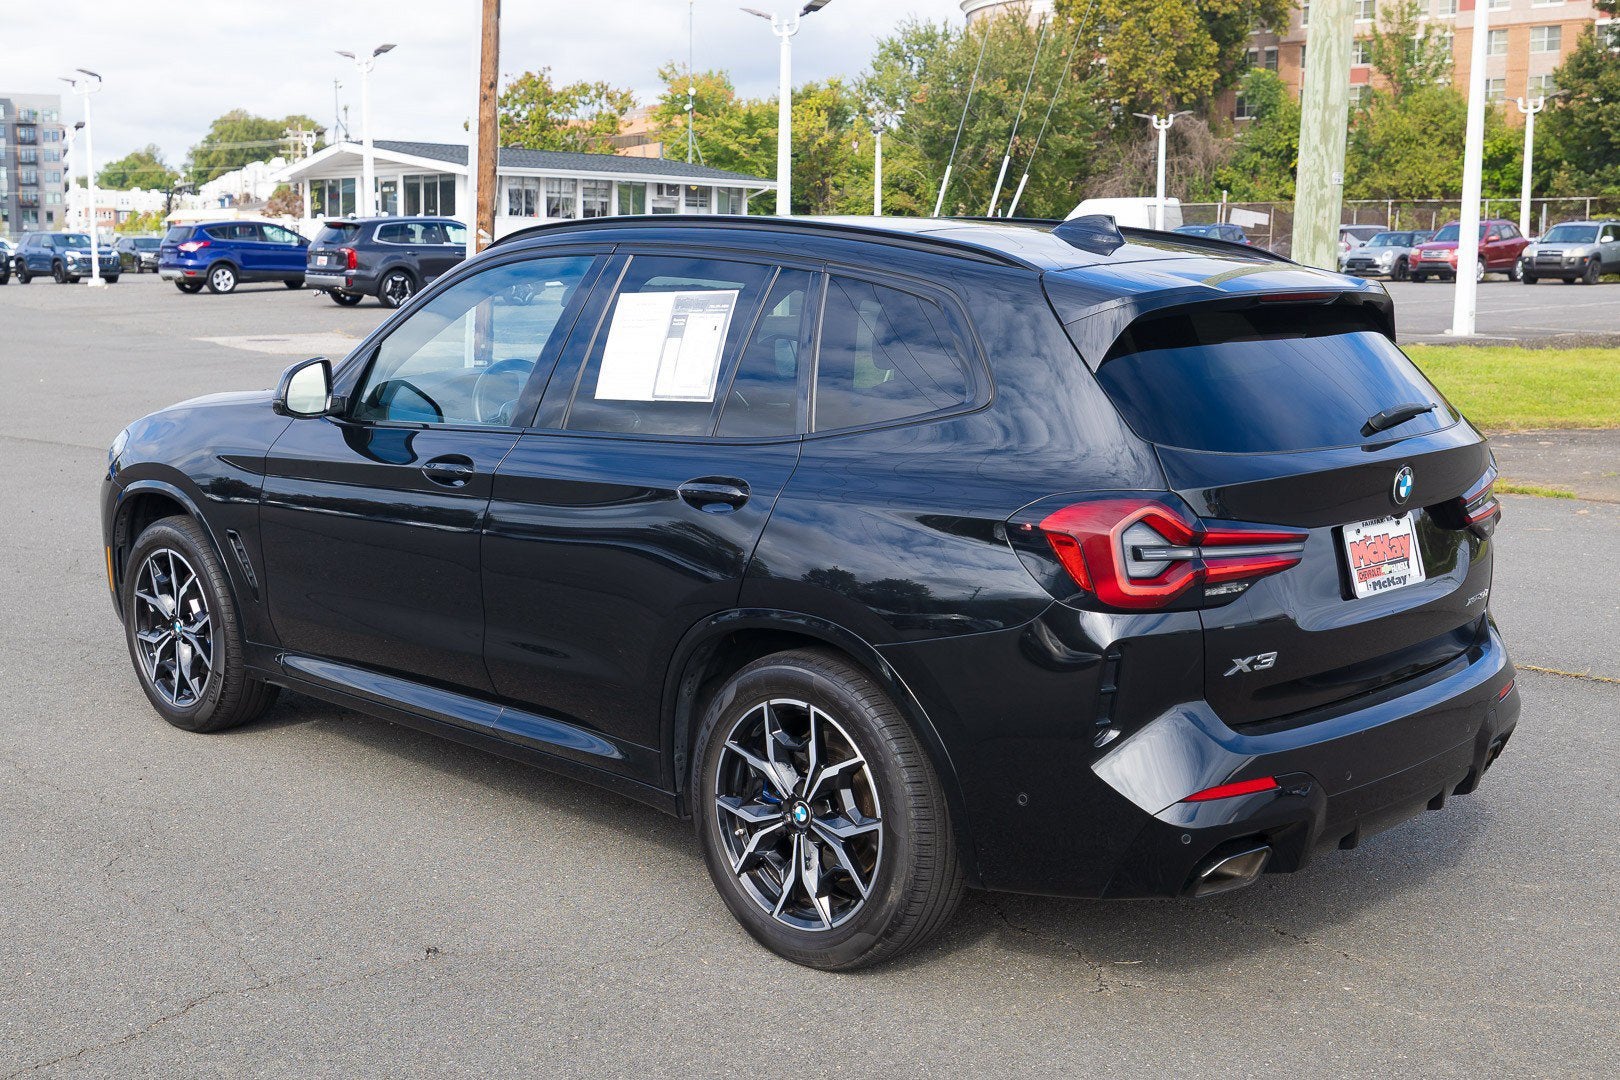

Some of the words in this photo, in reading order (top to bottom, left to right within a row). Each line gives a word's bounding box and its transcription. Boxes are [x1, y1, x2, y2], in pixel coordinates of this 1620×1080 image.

[1350, 533, 1410, 569] McKay
[1372, 574, 1407, 591] McKay
[1223, 651, 1278, 677] X3
